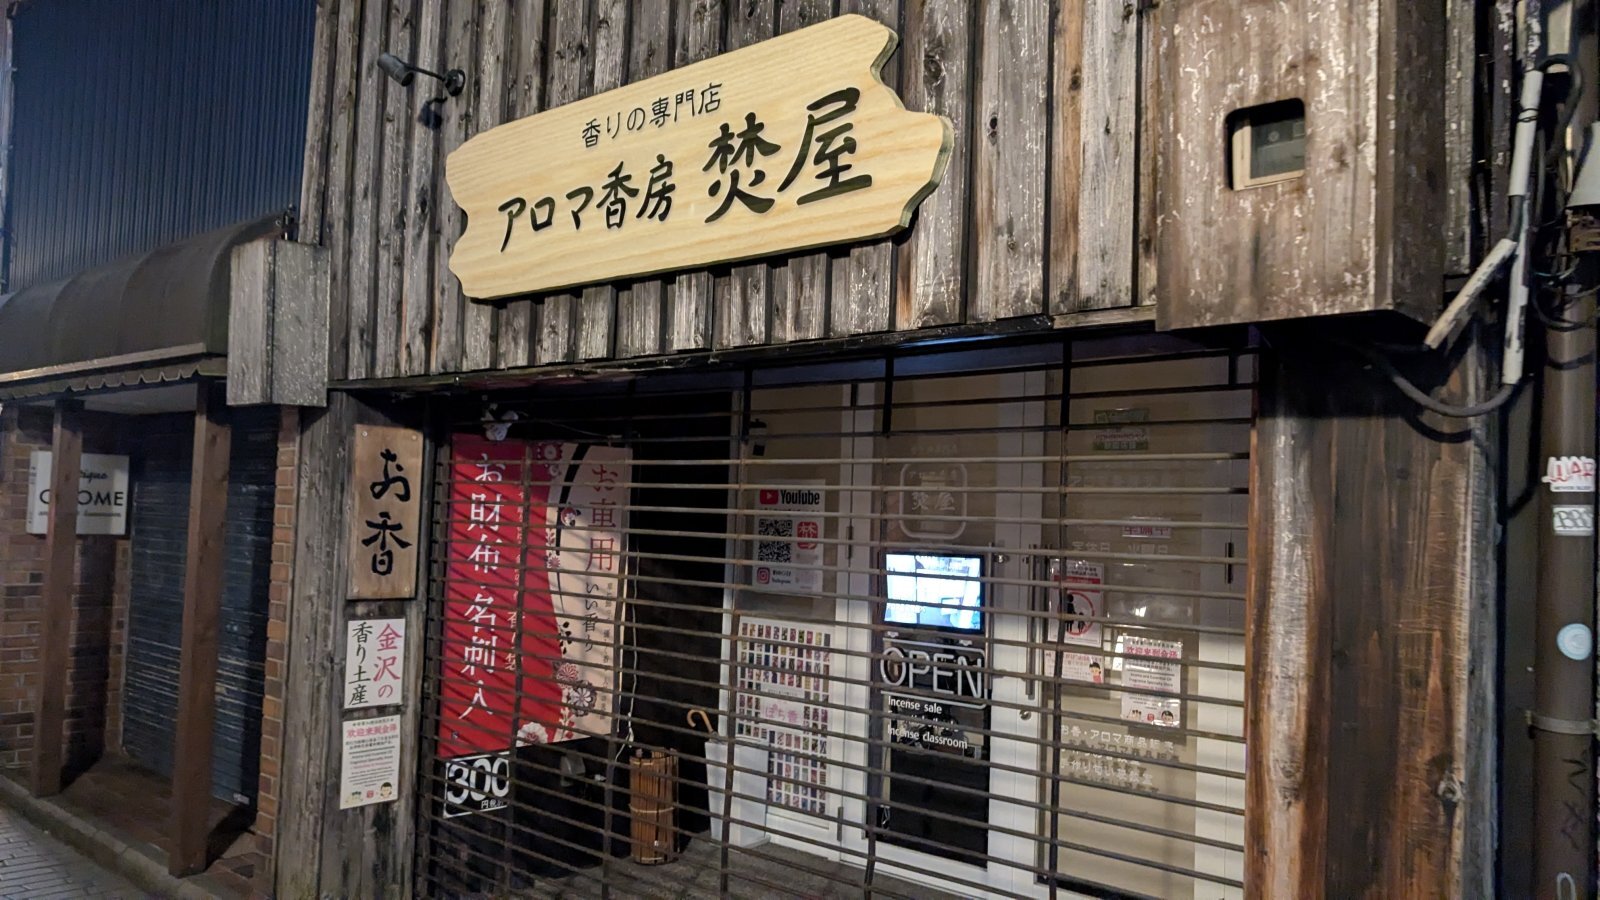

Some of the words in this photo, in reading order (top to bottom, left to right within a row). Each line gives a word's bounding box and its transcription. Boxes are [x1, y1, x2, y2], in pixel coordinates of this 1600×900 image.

[581, 82, 723, 148] 香りの専門店
[497, 153, 677, 253] アロマ香房
[701, 87, 873, 224] 焚屋
[361, 448, 413, 576] お香
[780, 489, 820, 505] YouTube
[348, 621, 373, 706] 香り土産
[373, 623, 402, 698] 金沢の
[880, 646, 982, 699] OPEN
[888, 695, 921, 710] Incense
[923, 702, 943, 714] sale
[887, 723, 920, 739] Incense
[922, 731, 968, 750] classroom
[446, 757, 509, 805] 300
